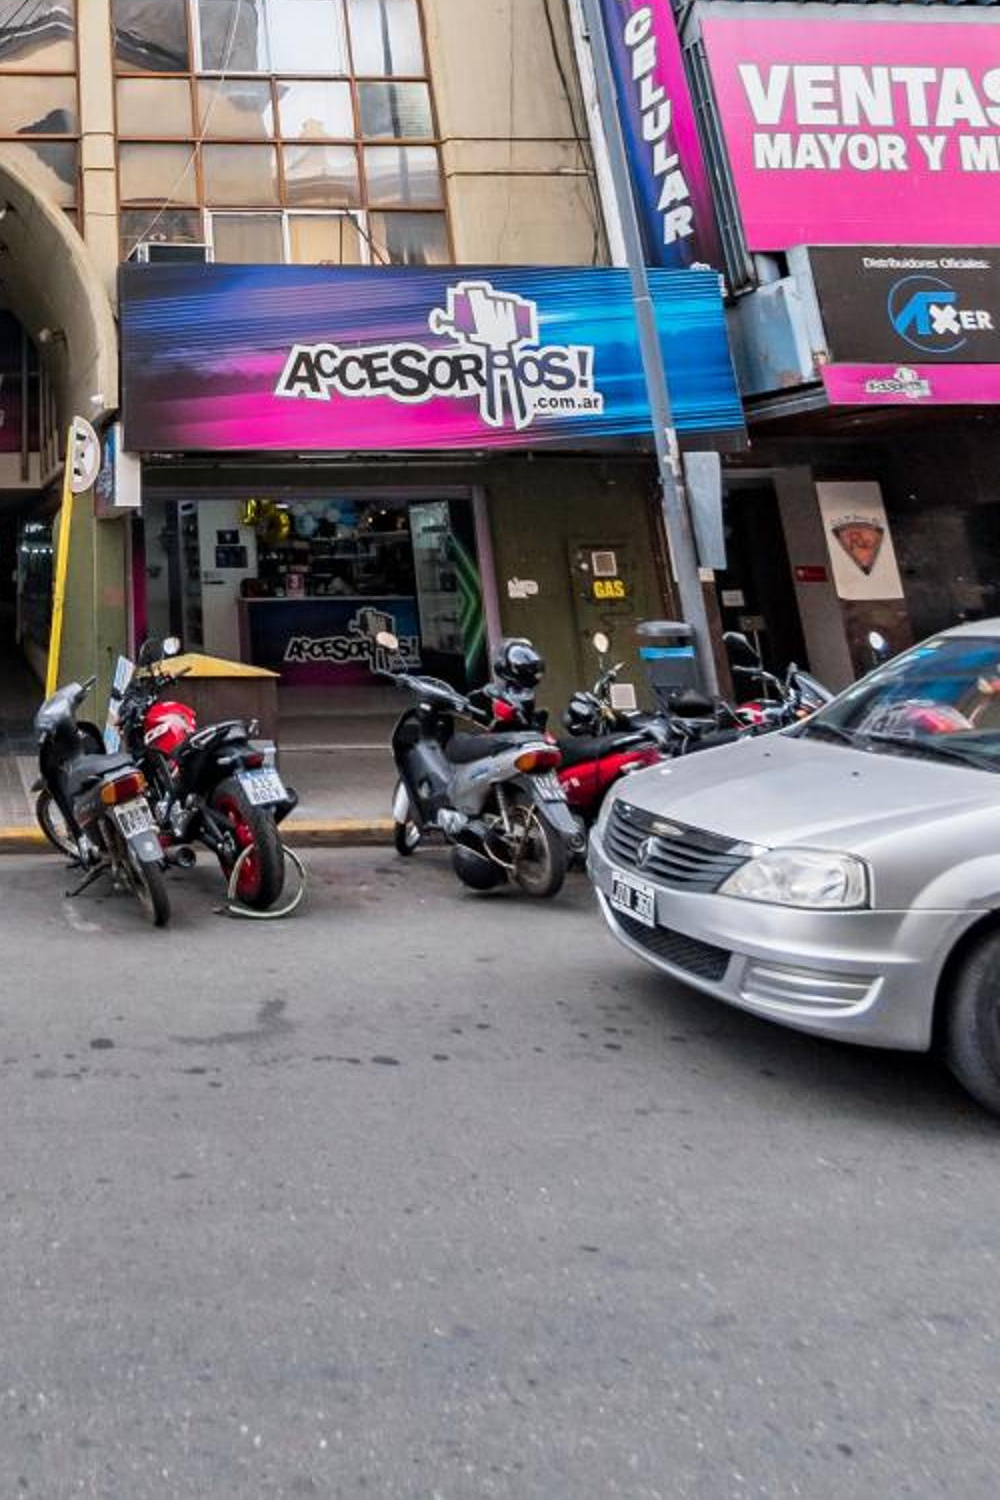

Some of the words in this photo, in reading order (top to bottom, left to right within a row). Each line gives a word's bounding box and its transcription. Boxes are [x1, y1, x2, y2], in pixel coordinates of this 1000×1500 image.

[623, 6, 694, 245] CELULAR
[753, 132, 908, 171] MAYOR
[917, 135, 946, 171] Y
[959, 135, 1000, 172] M
[593, 580, 625, 598] GAS
